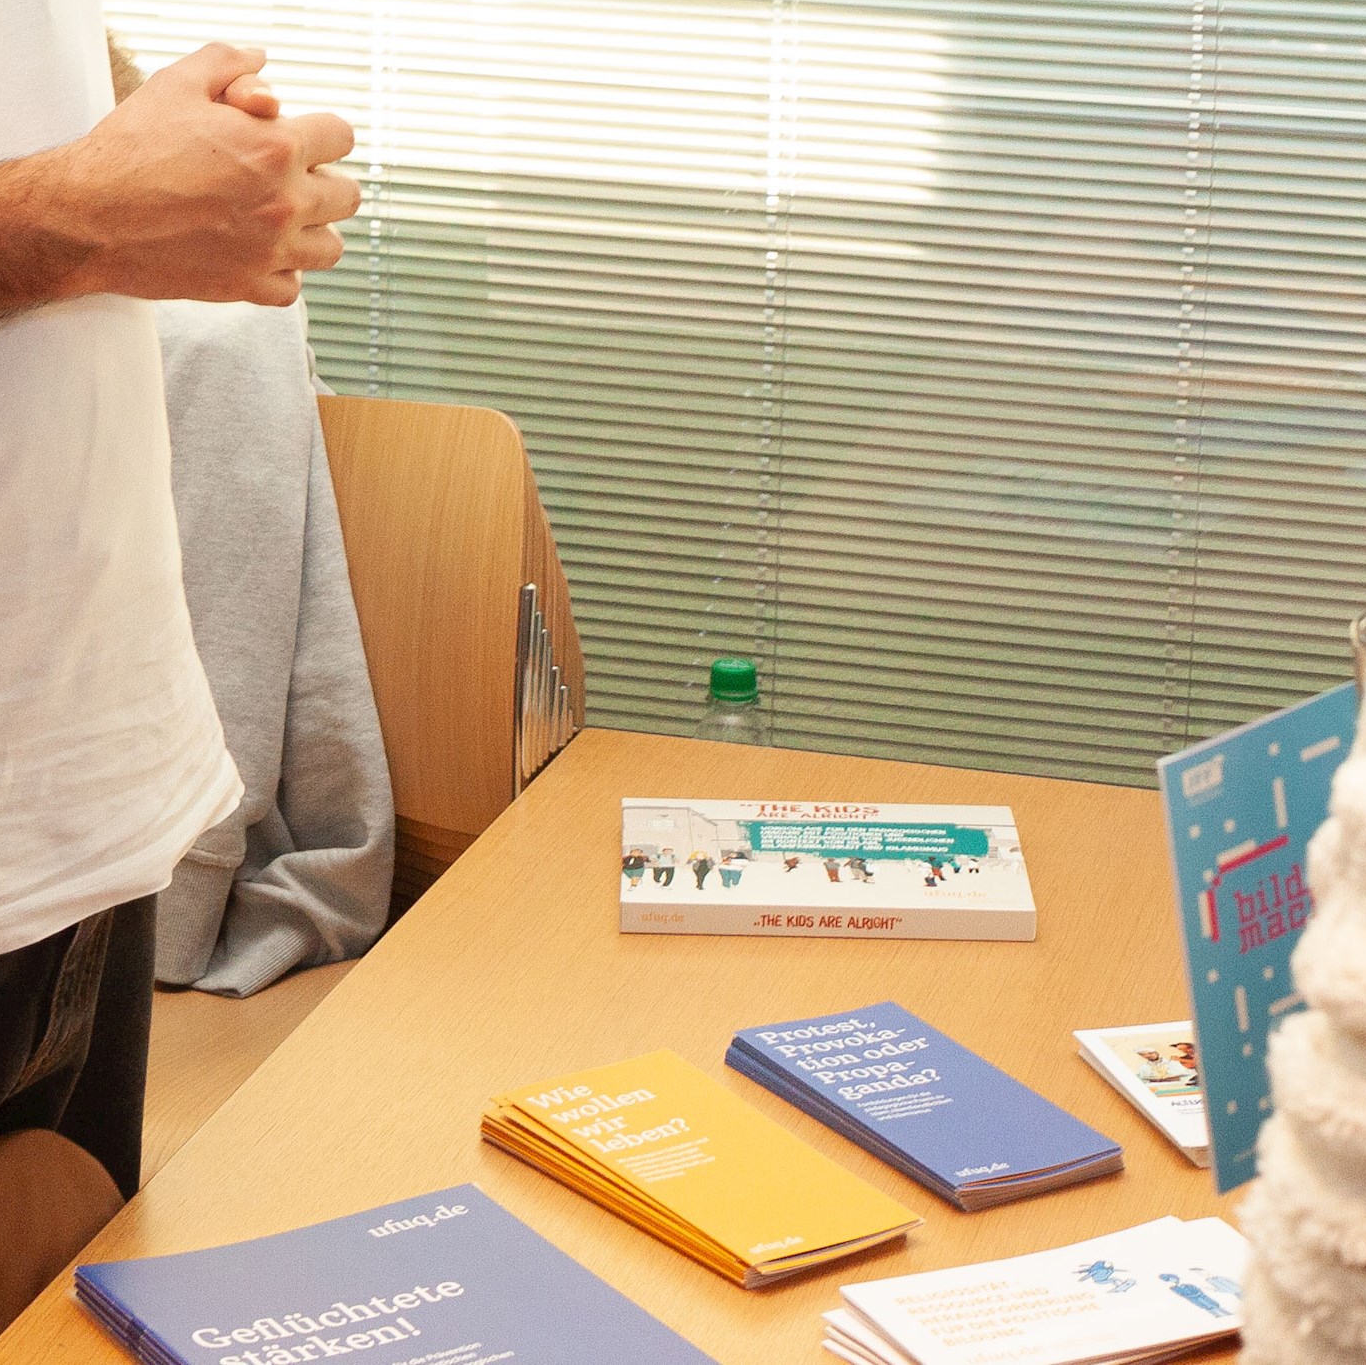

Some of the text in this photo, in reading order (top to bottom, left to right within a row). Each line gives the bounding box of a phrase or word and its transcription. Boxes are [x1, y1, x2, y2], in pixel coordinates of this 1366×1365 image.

[814, 804, 880, 814] KIDS
[1233, 863, 1311, 923] bild
[786, 914, 815, 928] KIDS
[819, 915, 843, 928] ARE
[1238, 890, 1315, 955] mac
[756, 1017, 876, 1046] Protest,
[775, 1028, 907, 1059] Provoka-
[796, 1036, 930, 1072] tion oder
[812, 1059, 916, 1085] Propa-
[837, 1068, 942, 1101] ganda?
[526, 1084, 594, 1111] Wie
[550, 1088, 657, 1124] wollen
[571, 1113, 629, 1139] wir
[588, 1117, 691, 1154] leben?
[367, 1202, 470, 1239] ufuq.de
[1011, 1287, 1049, 1301] UND
[191, 1280, 466, 1350] Geflüchtete
[969, 1319, 997, 1331] DIE
